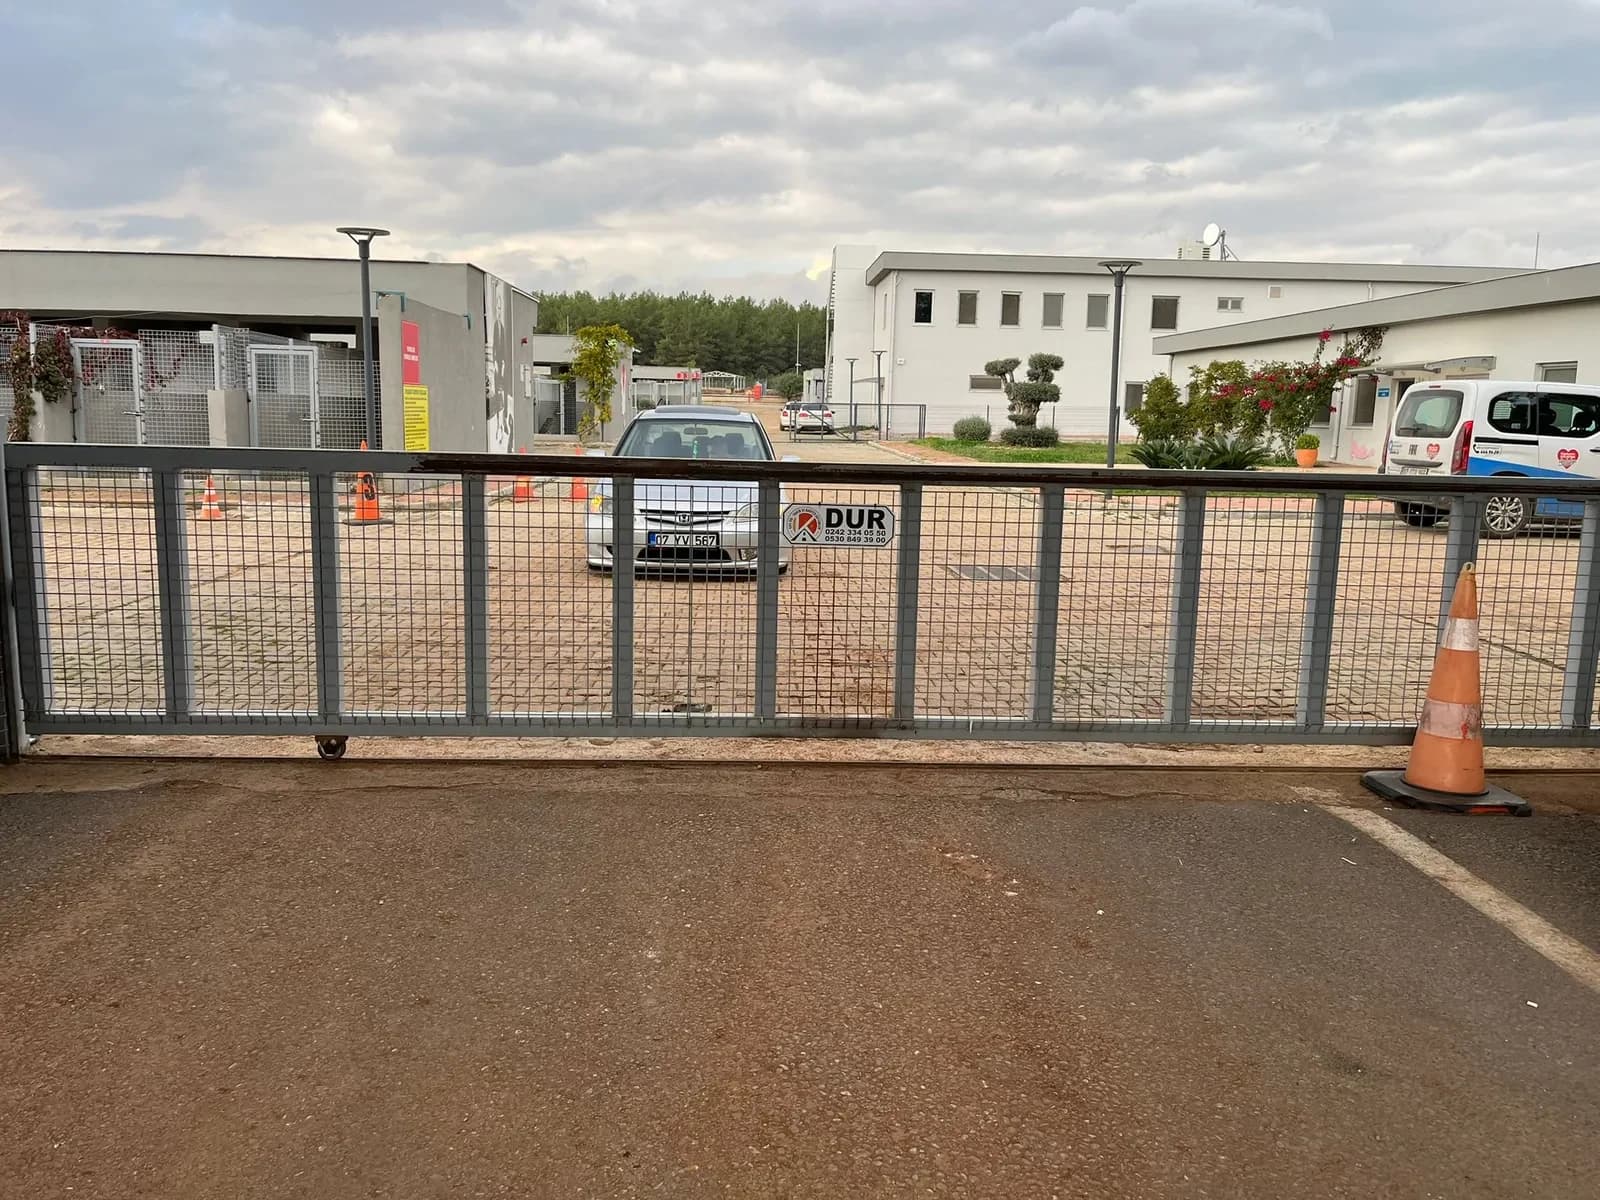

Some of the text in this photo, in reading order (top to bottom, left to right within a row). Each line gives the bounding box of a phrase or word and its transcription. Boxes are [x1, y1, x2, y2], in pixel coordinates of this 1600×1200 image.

[826, 508, 886, 529] DUR
[656, 535, 716, 546] 07 YV 567
